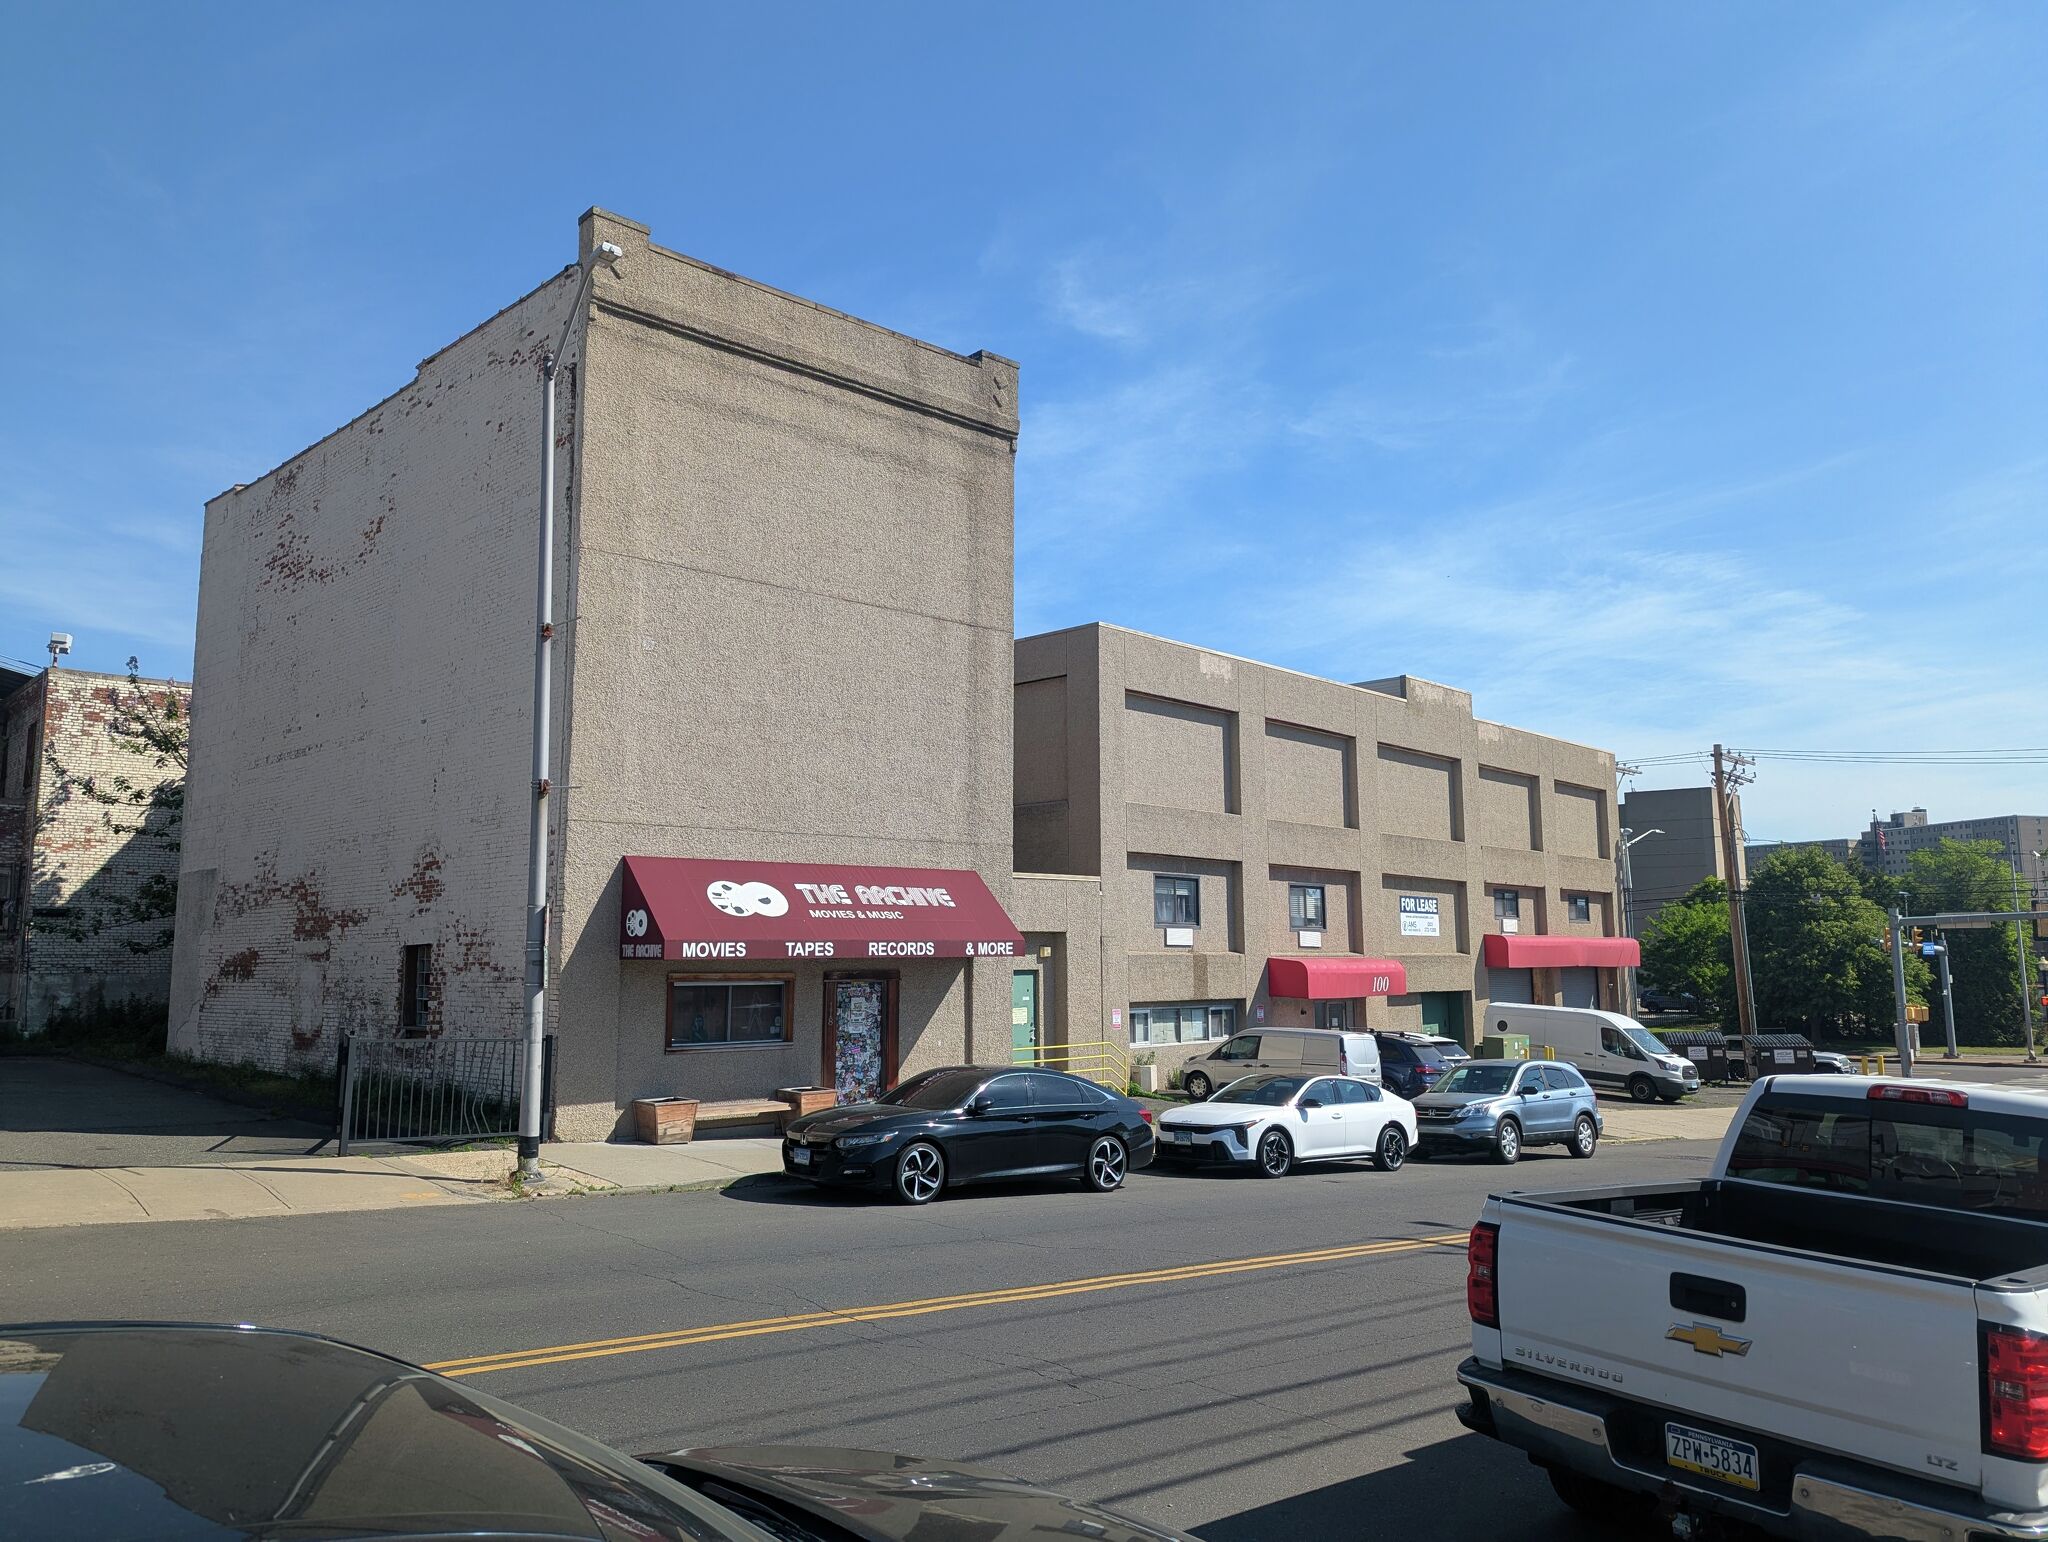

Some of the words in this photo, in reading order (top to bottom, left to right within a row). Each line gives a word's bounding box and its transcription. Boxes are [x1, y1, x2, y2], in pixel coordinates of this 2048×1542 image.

[794, 883, 853, 905] THE
[854, 885, 956, 908] ARCHIVE
[1401, 897, 1416, 911] FOR
[1416, 899, 1438, 913] LEASE
[809, 909, 856, 919] MOVIES
[856, 911, 866, 919] &
[866, 911, 904, 920] MUSIC
[622, 944, 634, 958] THE
[635, 944, 662, 958] ARCHIVE
[682, 942, 747, 958] MOVIES
[785, 942, 834, 956] TAPES
[868, 942, 935, 956] RECORDS
[965, 942, 975, 955] &
[977, 942, 1014, 955] MORE
[1373, 976, 1389, 992] 100
[1515, 1346, 1623, 1383] SILVERADO
[1688, 1431, 1734, 1448] PENNSYLVANIA
[1926, 1454, 1958, 1471] LTZ
[1699, 1466, 1728, 1479] TRUCK
